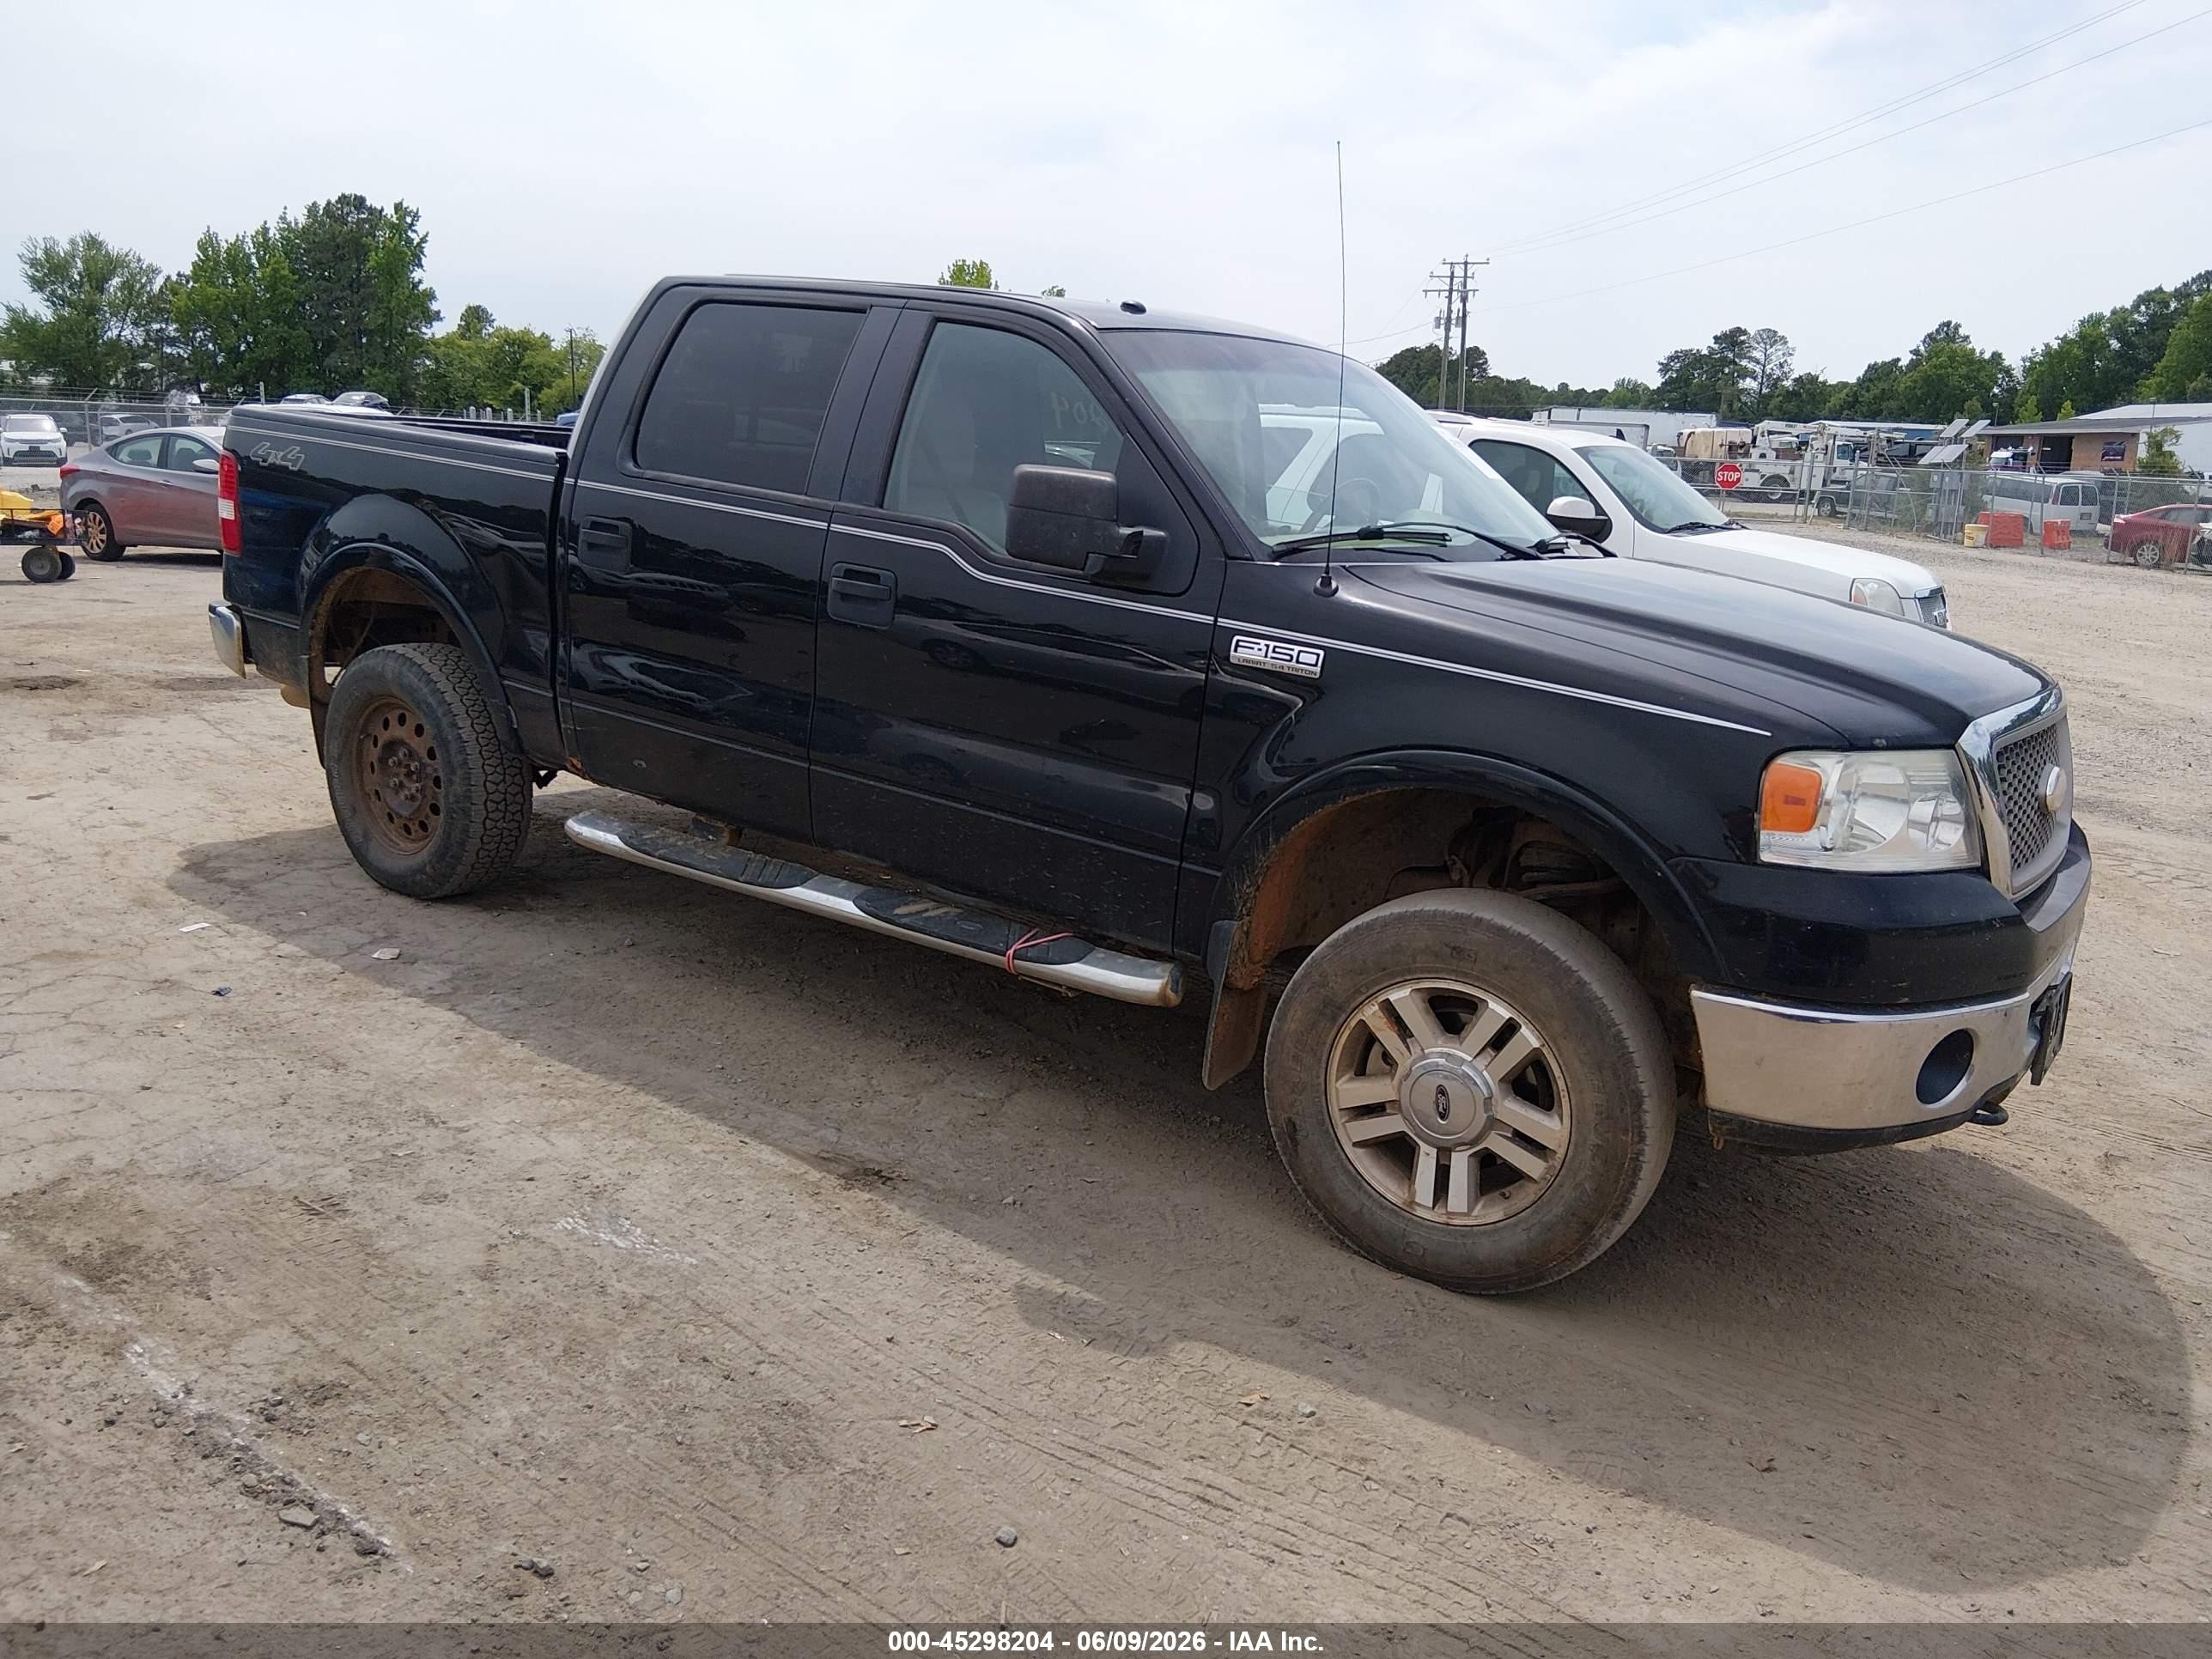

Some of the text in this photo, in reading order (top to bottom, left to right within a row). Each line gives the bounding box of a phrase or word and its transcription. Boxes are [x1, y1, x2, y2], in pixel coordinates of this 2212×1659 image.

[250, 441, 304, 471] 4x4
[1717, 471, 1741, 482] STOP
[1234, 639, 1321, 667] F-150
[1237, 657, 1266, 667] LARIAT
[1285, 665, 1318, 677] TRITON
